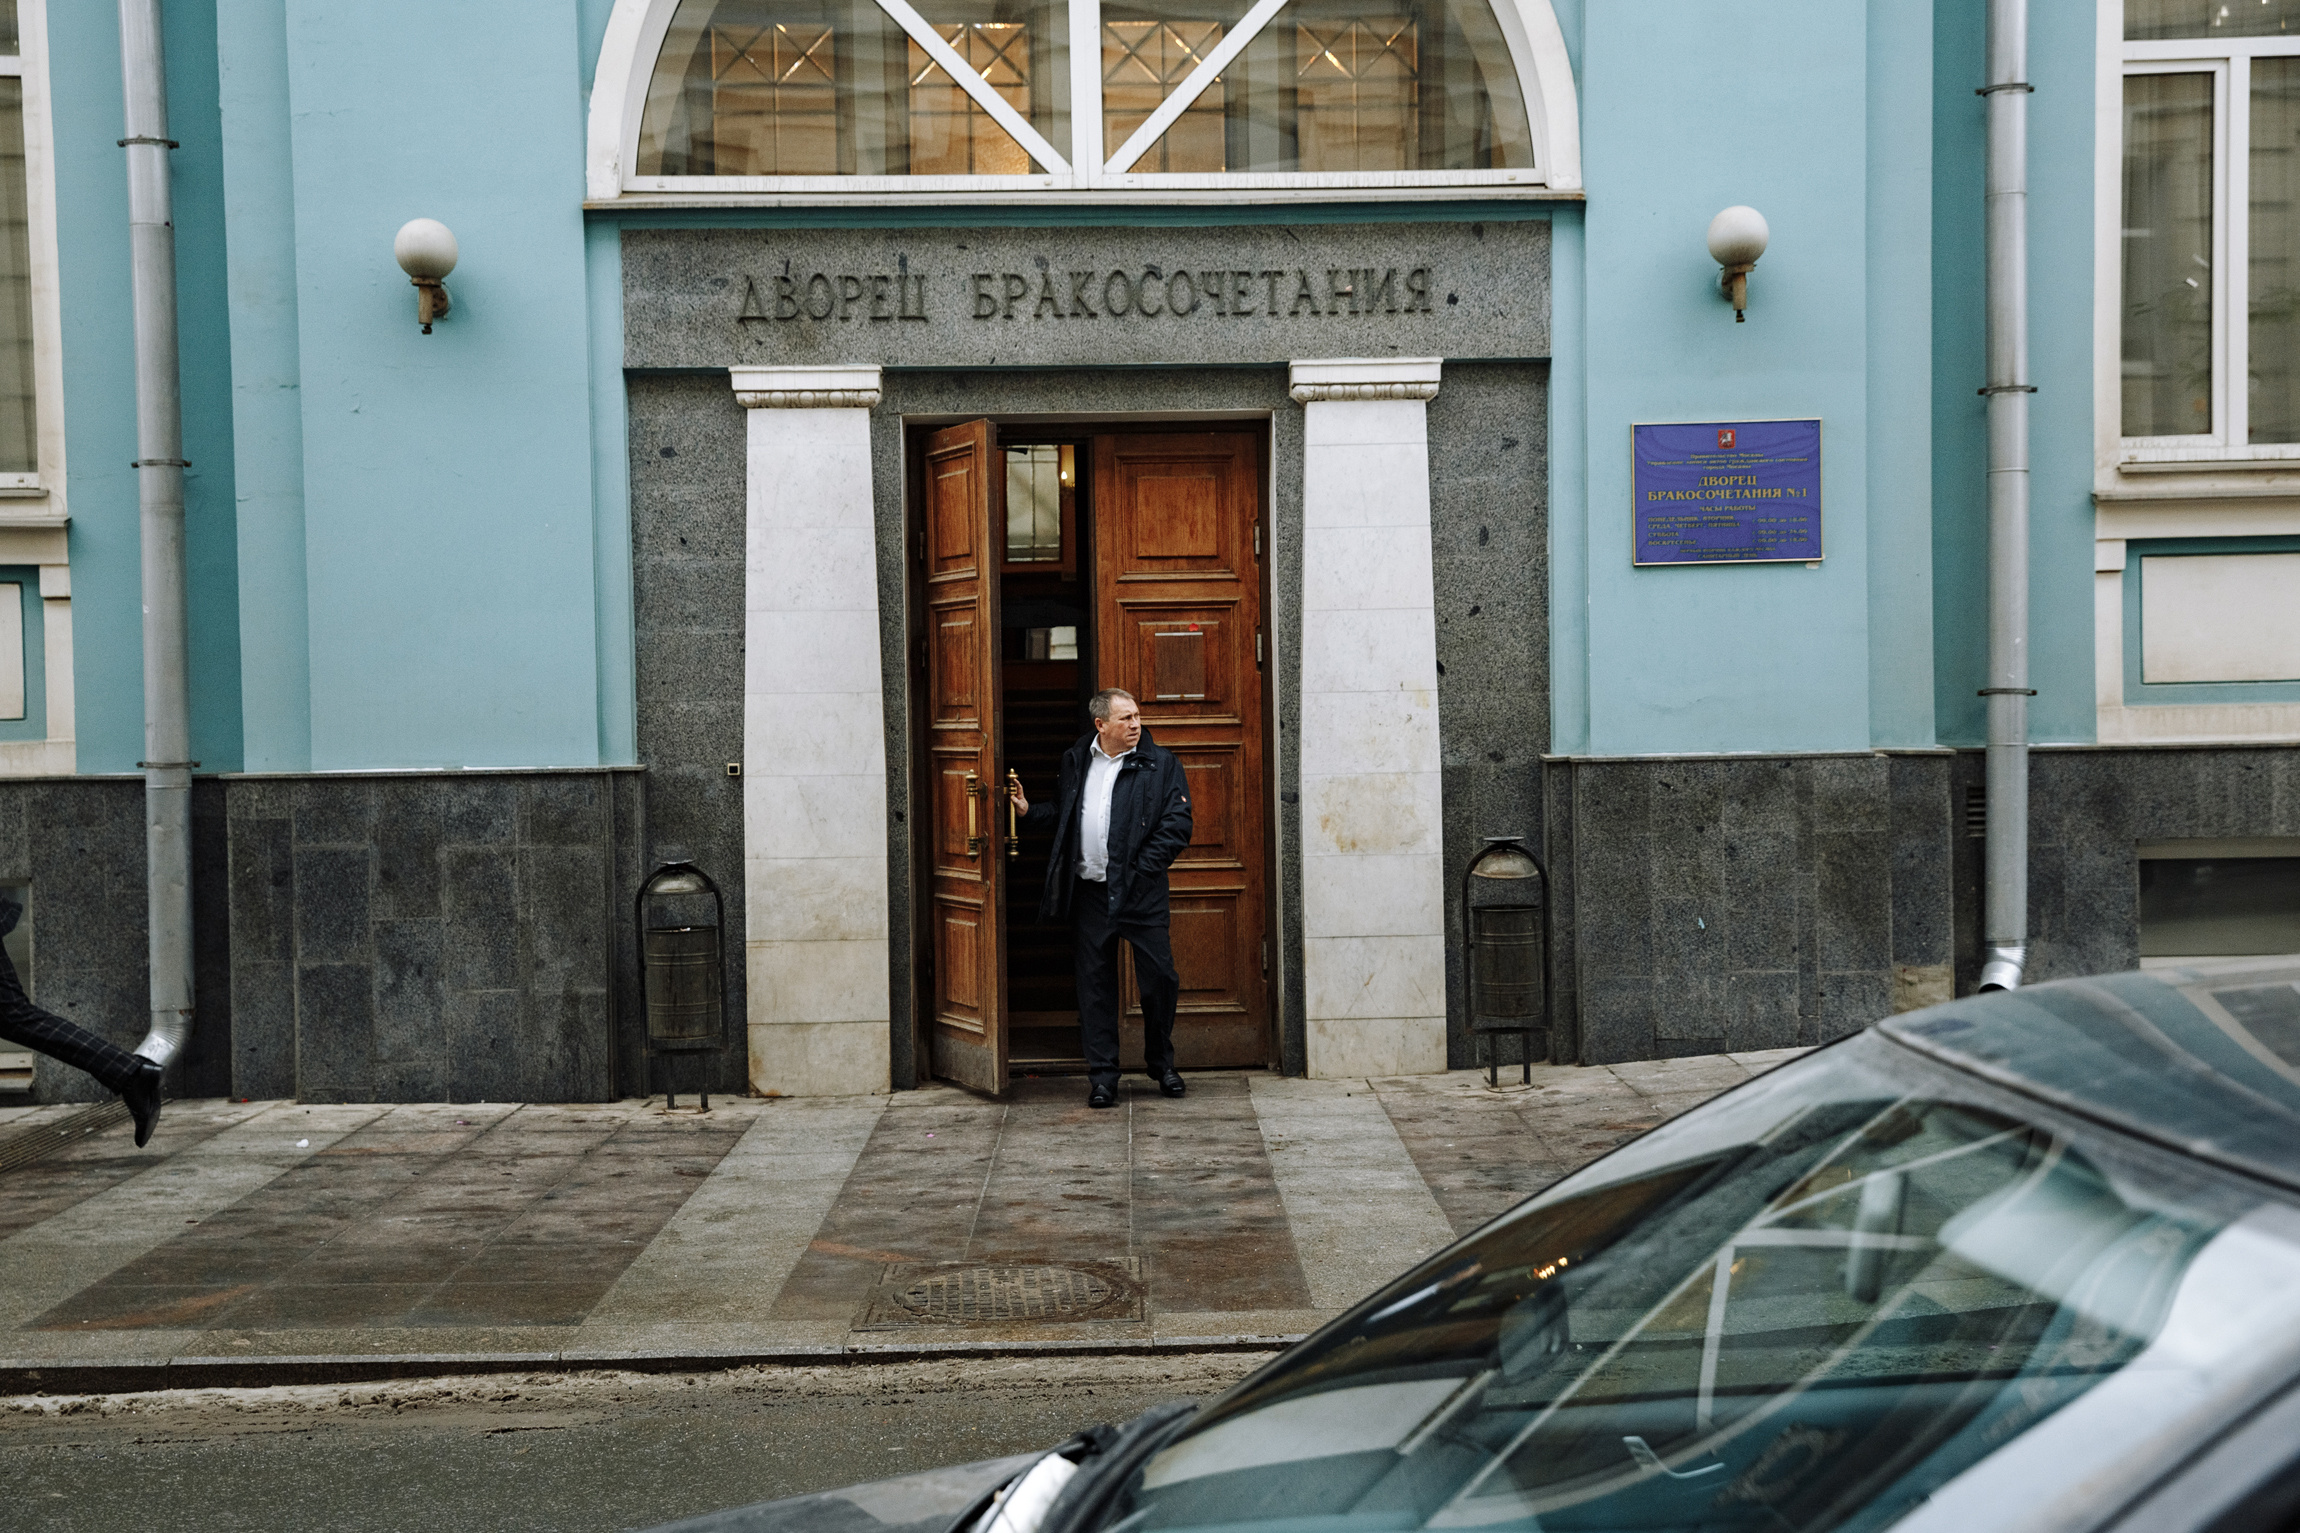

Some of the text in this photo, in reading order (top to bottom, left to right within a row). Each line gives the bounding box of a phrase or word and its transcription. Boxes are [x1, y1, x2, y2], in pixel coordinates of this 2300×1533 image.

[738, 268, 1432, 331] ДВОРЕЦ БРАКОСОЧЕТАНИЯ
[1698, 475, 1757, 487] ДВОРЕЦ
[1648, 488, 1782, 501] БРАКОСОЧЕТАНИЯ
[1724, 504, 1756, 512] РАБОТЫ
